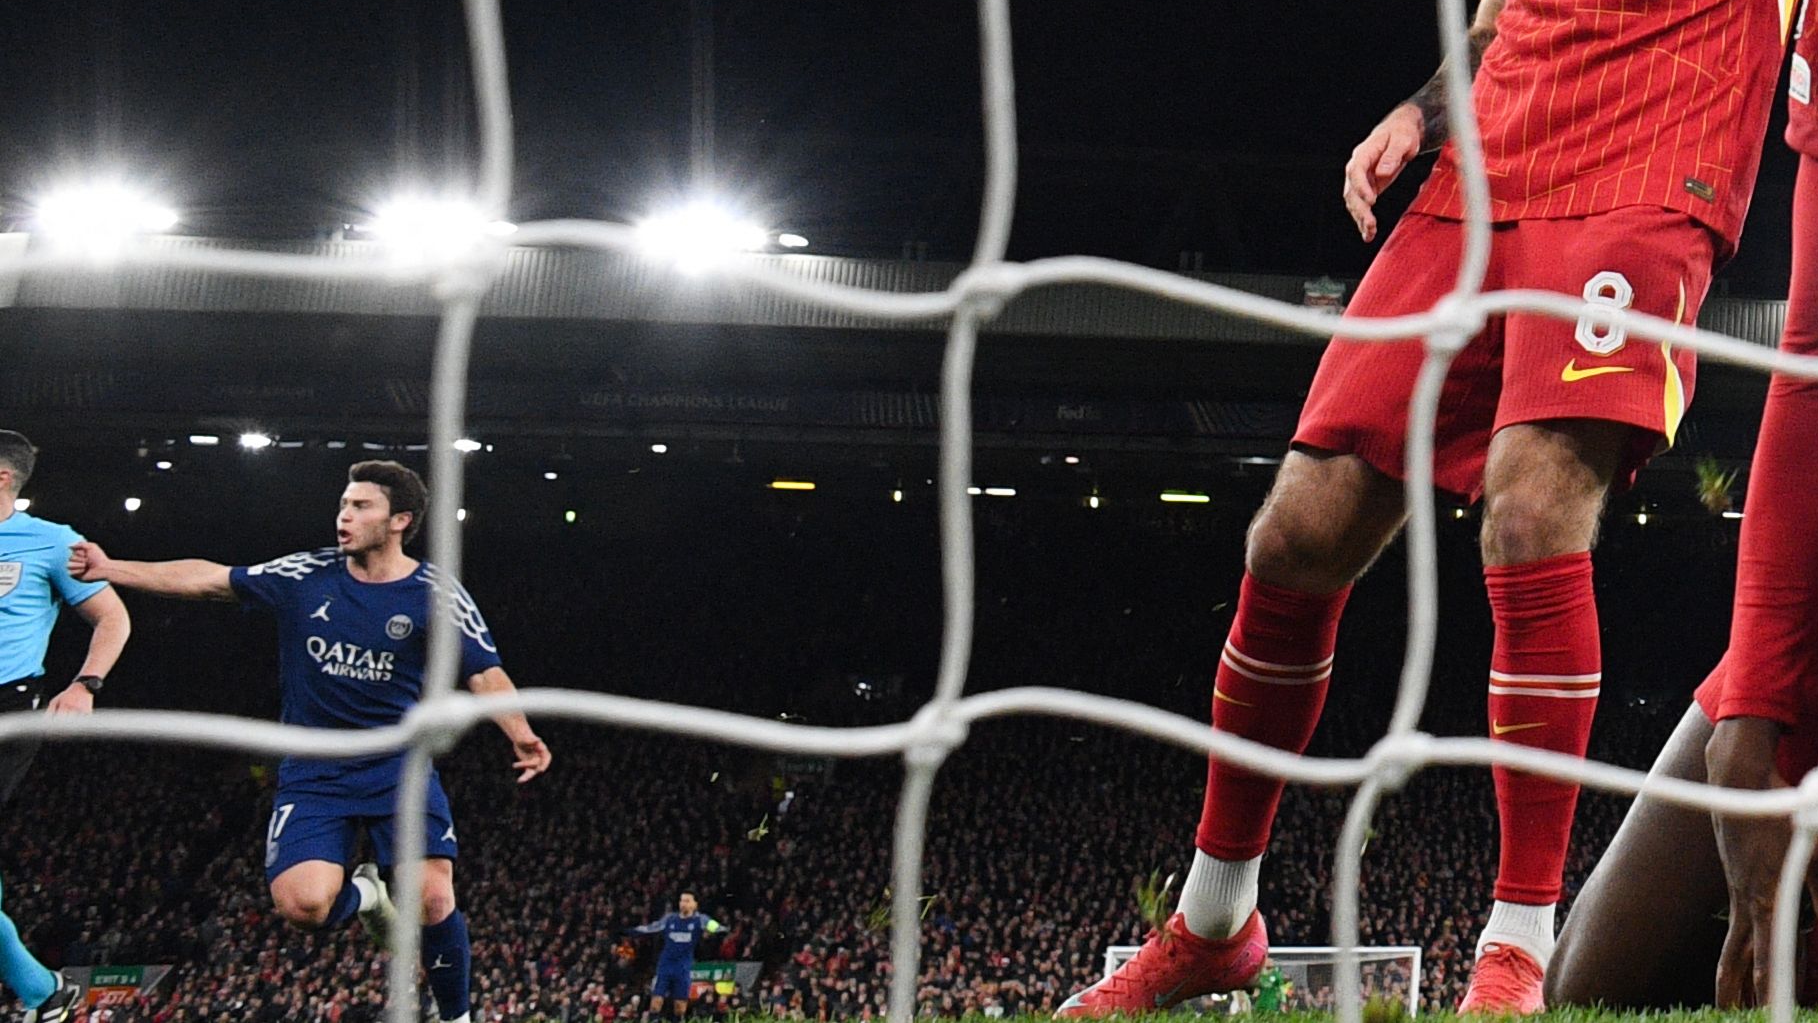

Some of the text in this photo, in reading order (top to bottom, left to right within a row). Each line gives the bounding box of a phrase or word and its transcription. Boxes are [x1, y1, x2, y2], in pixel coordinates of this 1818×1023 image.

[1574, 271, 1634, 355] 8
[306, 635, 395, 671] QATAR
[321, 661, 393, 682] AIRWAYS
